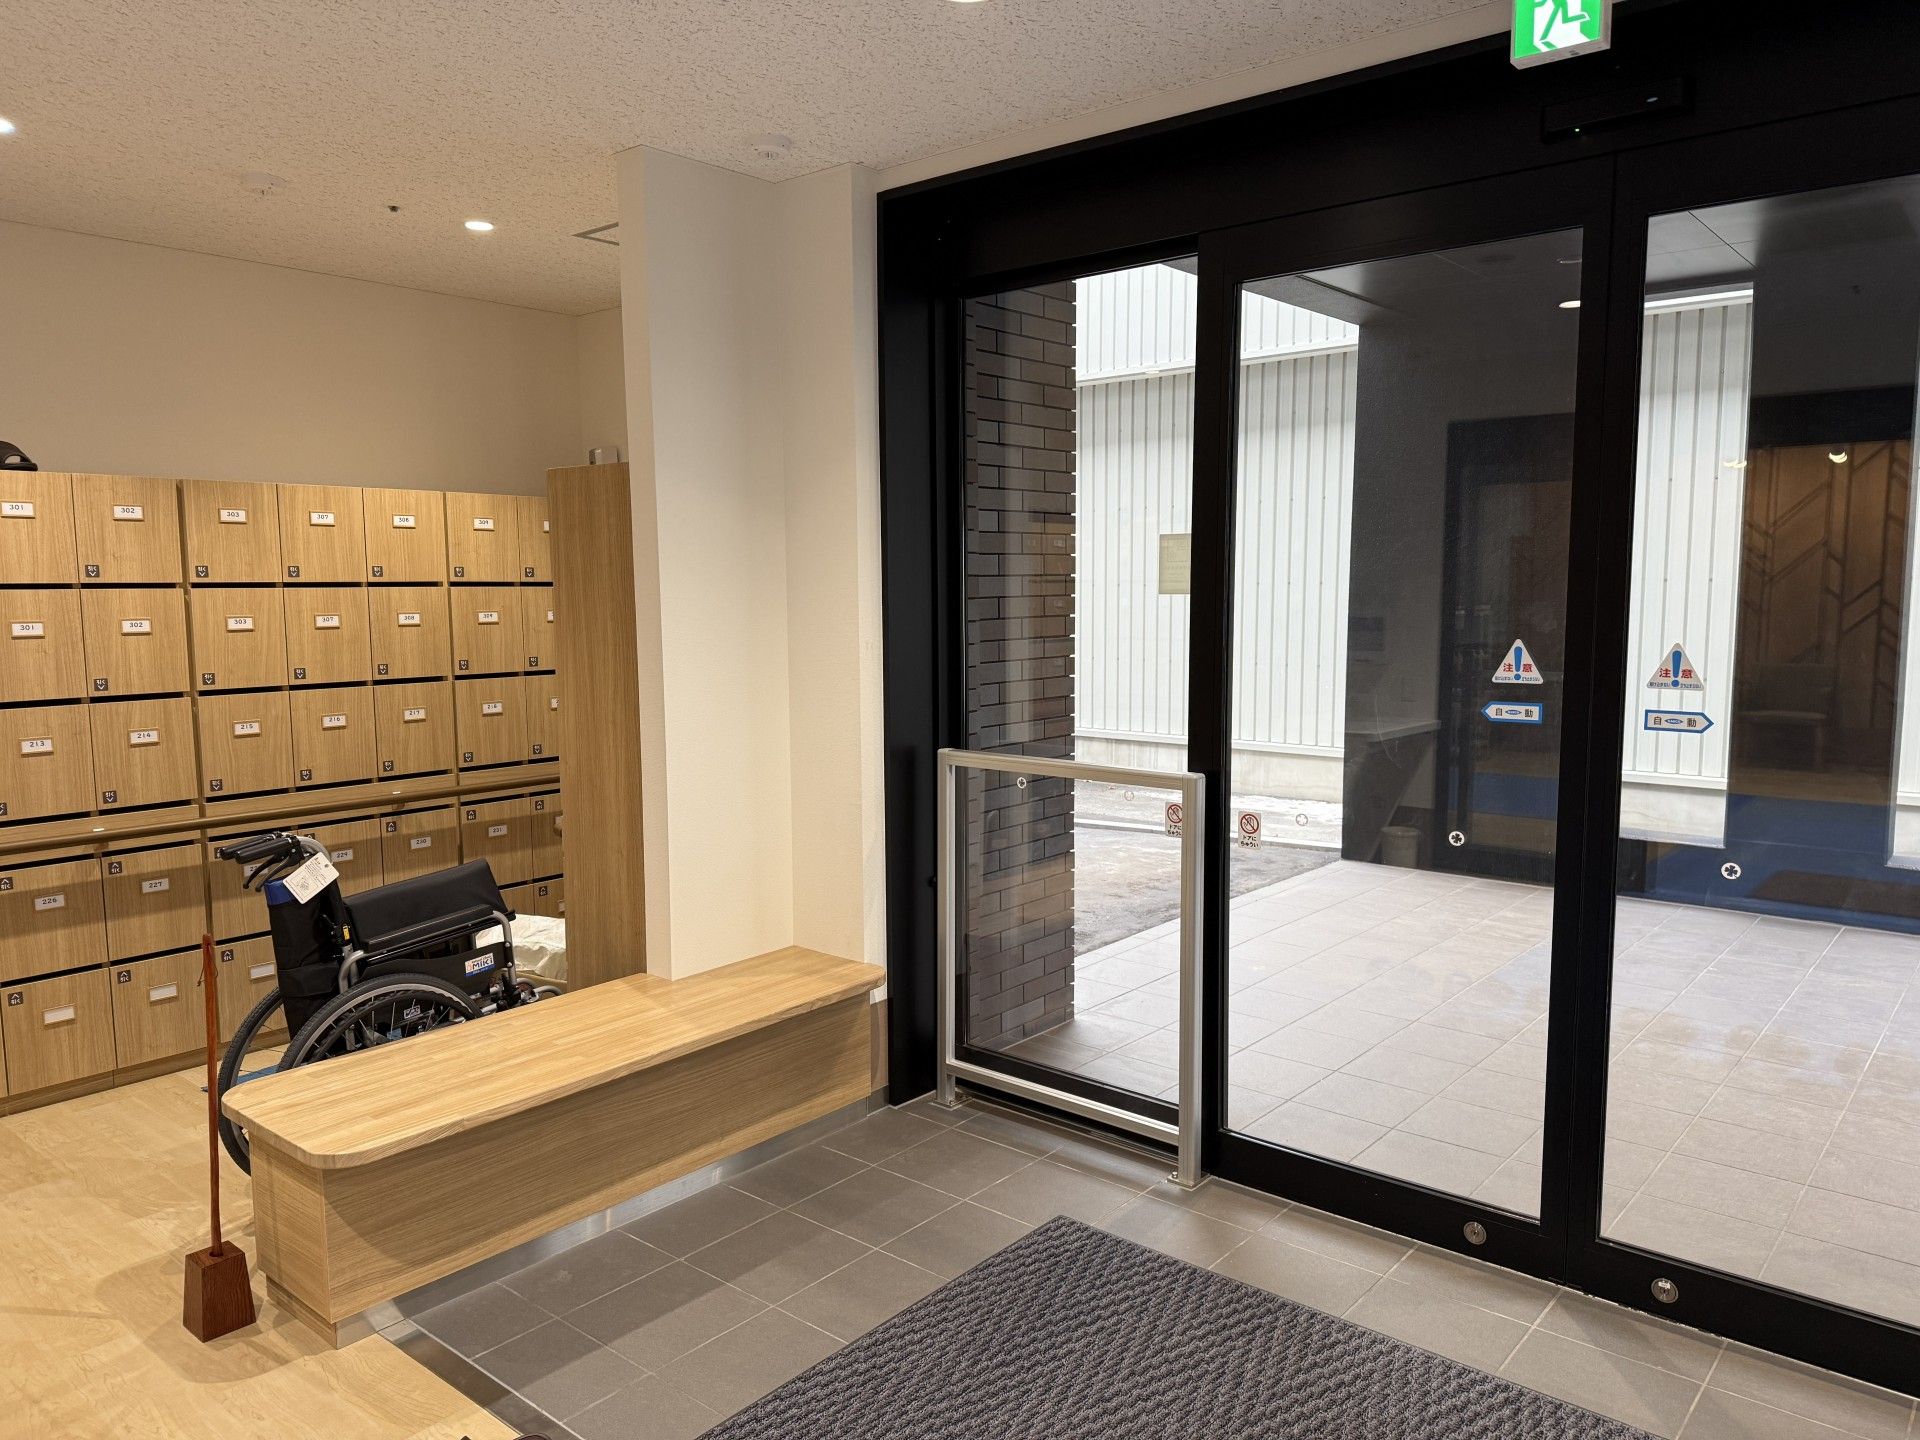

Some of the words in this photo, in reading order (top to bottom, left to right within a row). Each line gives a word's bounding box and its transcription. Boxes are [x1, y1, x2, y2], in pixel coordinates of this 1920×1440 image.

[9, 504, 24, 512] 301
[29, 740, 45, 748] 213
[149, 881, 163, 889] 227
